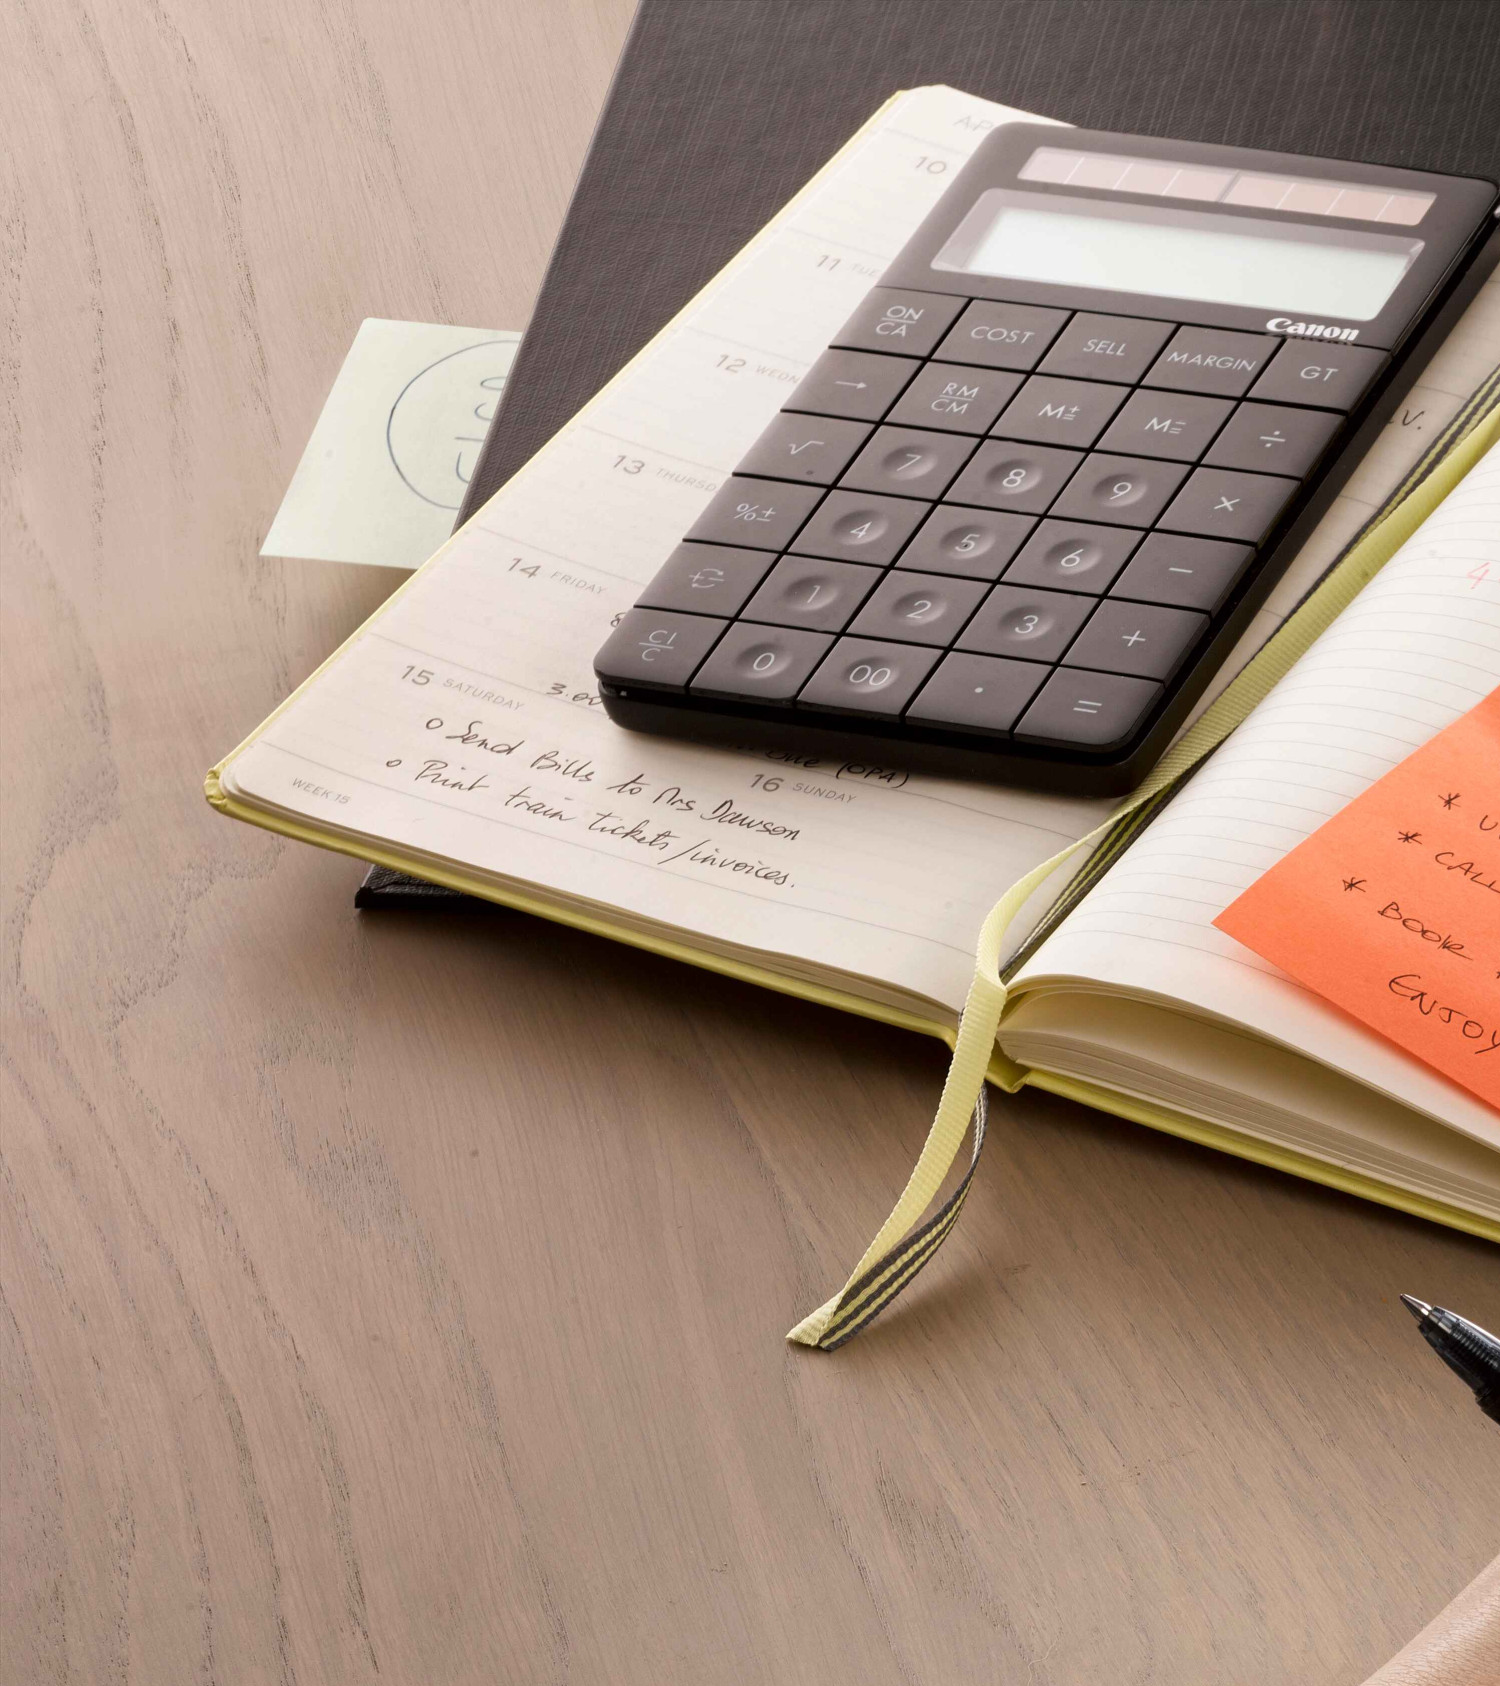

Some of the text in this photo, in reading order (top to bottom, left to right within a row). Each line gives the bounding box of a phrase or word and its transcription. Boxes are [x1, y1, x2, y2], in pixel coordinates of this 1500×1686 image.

[915, 155, 947, 175] 10
[816, 254, 841, 272] 11
[886, 305, 924, 322] ON
[876, 321, 909, 337] CA
[971, 325, 1034, 346] COST
[1265, 317, 1359, 343] Canon
[1083, 338, 1126, 357] SELL
[716, 353, 747, 375] 12
[1168, 350, 1256, 372] MARGIN
[1301, 364, 1338, 382] GT
[942, 382, 978, 398] RM
[931, 398, 969, 415] CM
[613, 454, 647, 477] 13
[897, 454, 923, 474] 7
[1003, 468, 1027, 489] 8
[1112, 481, 1132, 501] 9
[850, 522, 872, 539] 4
[955, 534, 976, 553] 5
[1060, 549, 1082, 569] 6
[508, 557, 607, 596] 14 FRIDAY
[809, 585, 822, 604] 1
[907, 600, 932, 620] 2
[1015, 615, 1039, 635] 3
[753, 652, 775, 671] 0
[849, 664, 891, 686] 00
[400, 664, 526, 711] 15 SATURDAY
[291, 777, 332, 800] WEEK
[415, 758, 579, 822] Print train
[446, 720, 525, 756] Send
[530, 750, 595, 783] Bills
[606, 774, 651, 797] to
[700, 797, 802, 843] Dawson
[750, 773, 857, 805] 16 SUNDAY
[1378, 901, 1475, 962] BOOK
